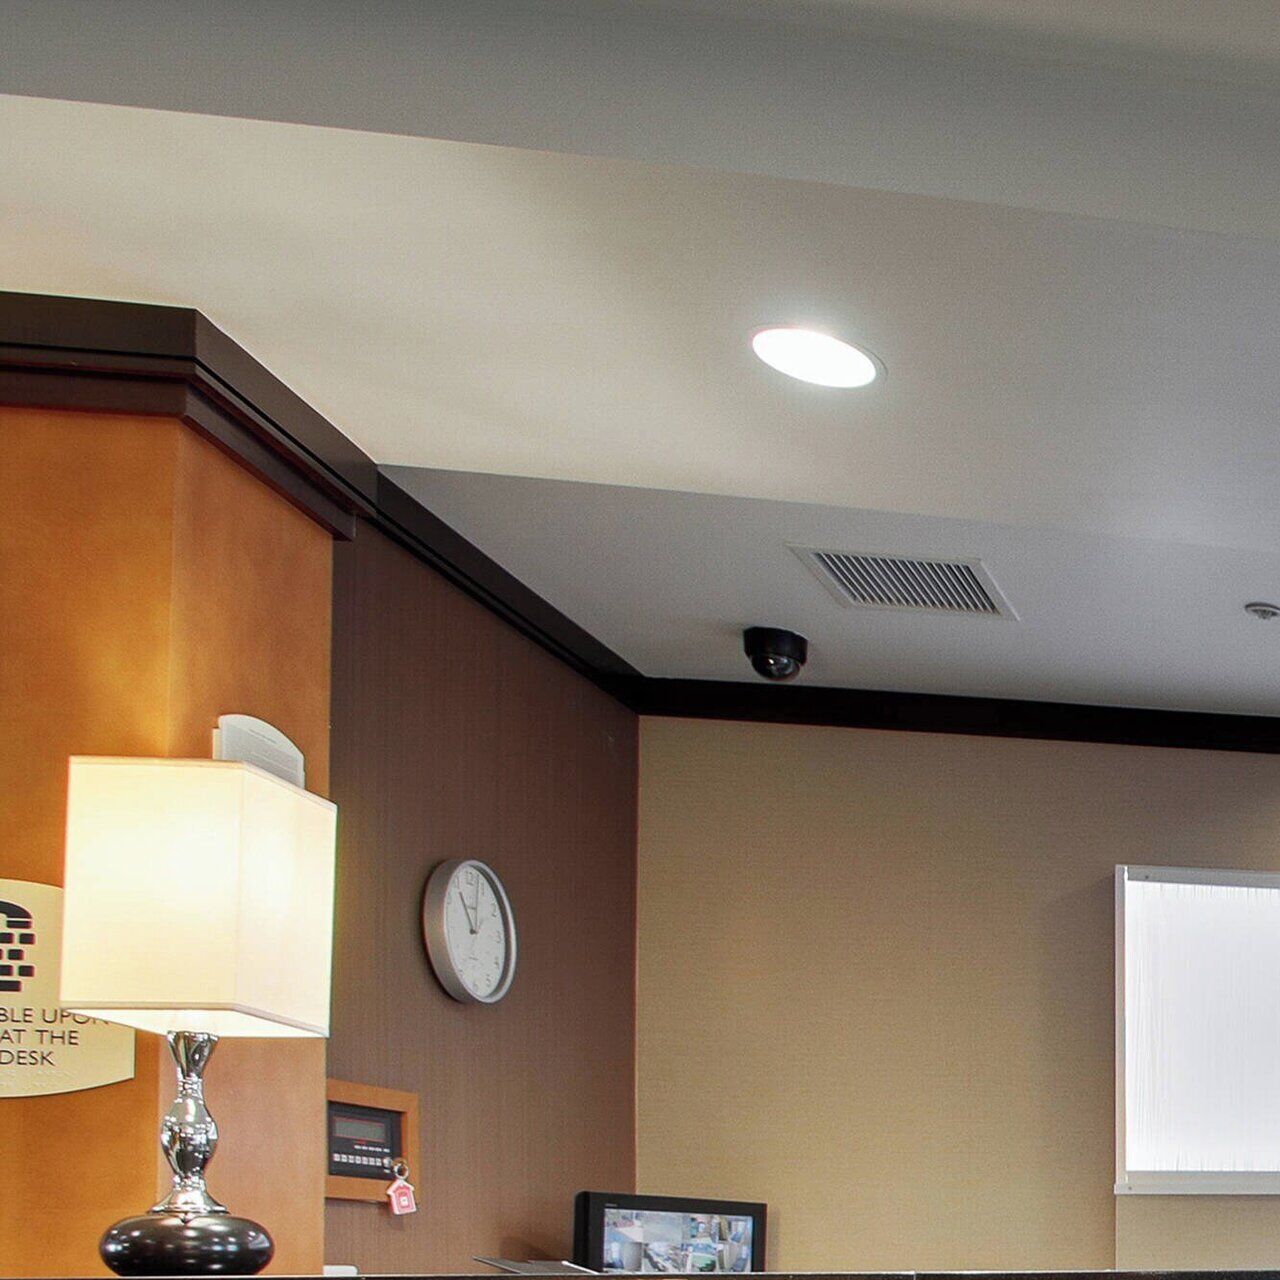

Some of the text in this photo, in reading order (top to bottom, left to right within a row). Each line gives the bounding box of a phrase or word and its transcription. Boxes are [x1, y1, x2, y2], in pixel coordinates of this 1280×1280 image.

[0, 1029, 79, 1046] AT THE
[0, 1049, 56, 1067] DESK
